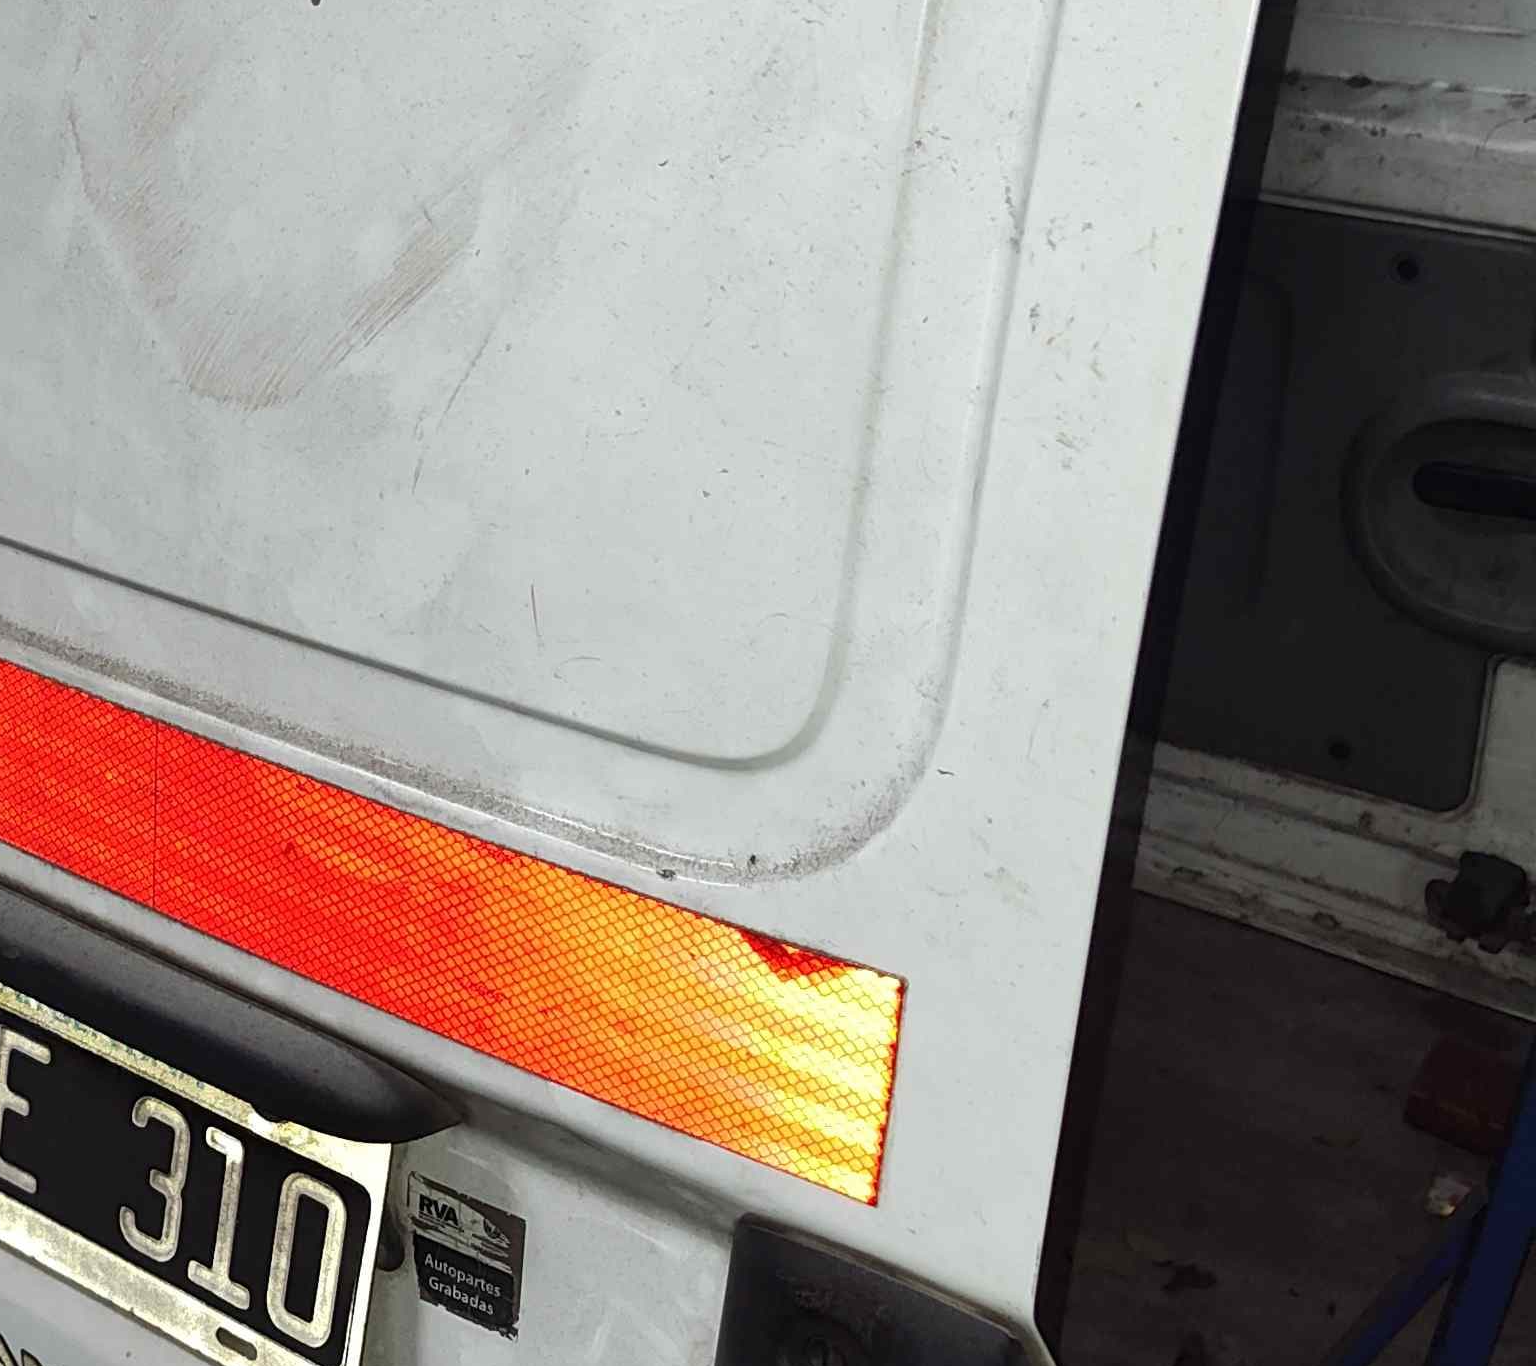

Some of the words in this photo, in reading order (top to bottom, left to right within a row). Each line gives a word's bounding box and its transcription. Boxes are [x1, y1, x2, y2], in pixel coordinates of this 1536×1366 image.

[119, 1095, 348, 1347] 310
[419, 1194, 458, 1226] RVA
[424, 1253, 502, 1298] Autopartes
[428, 1276, 494, 1316] Grabadas
